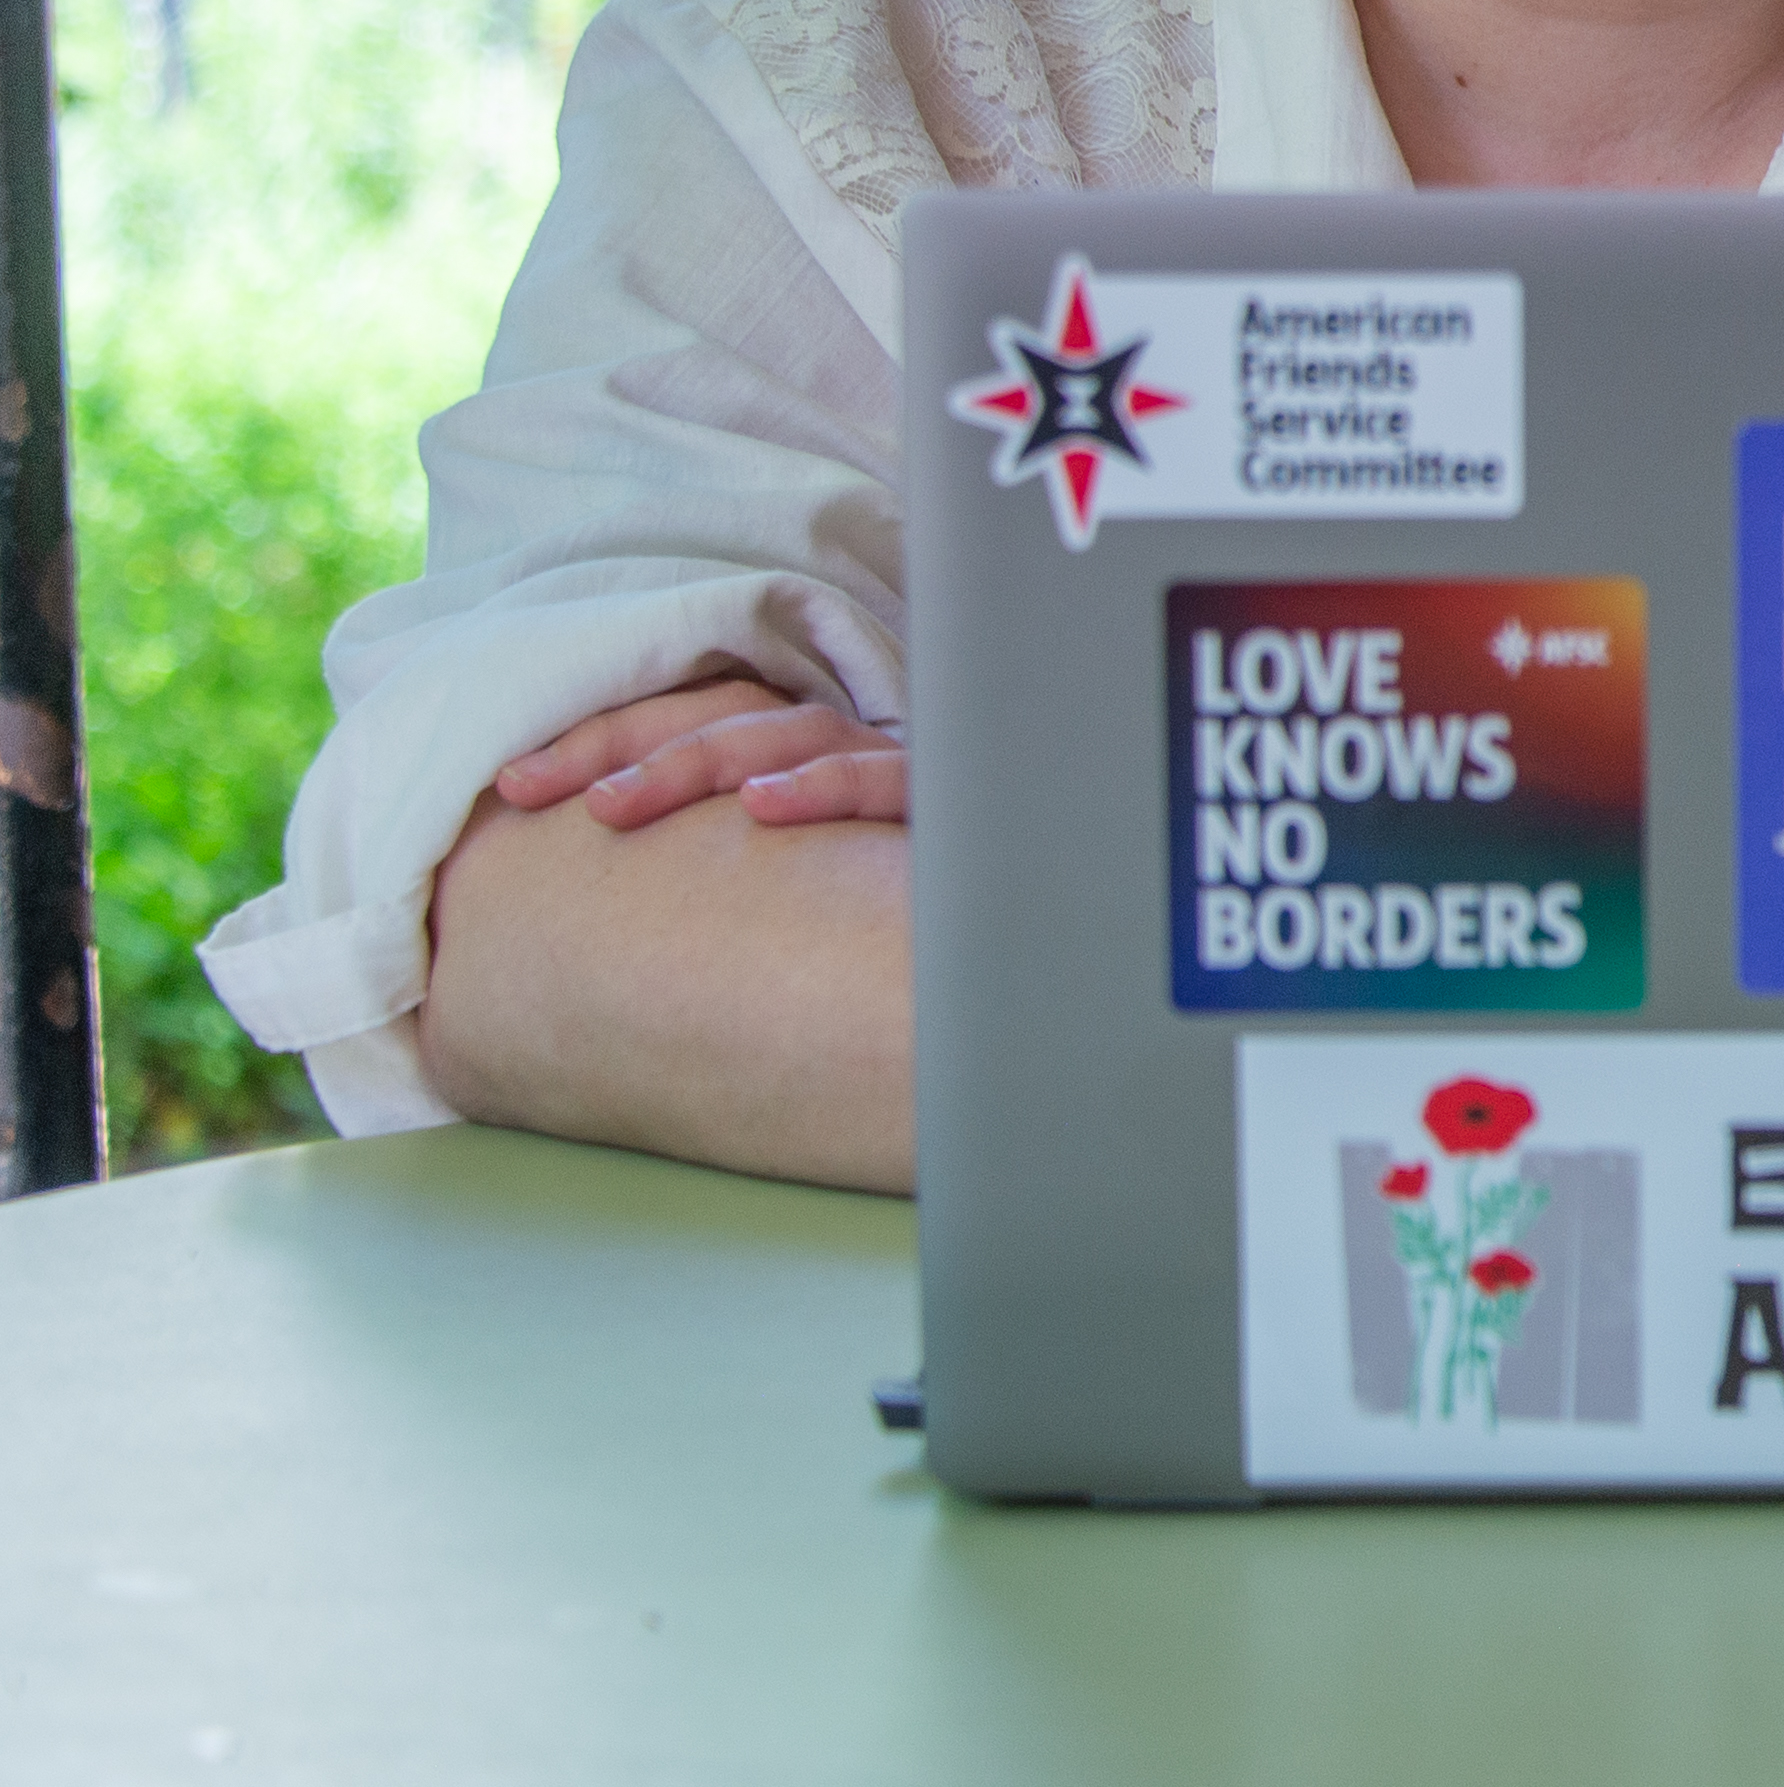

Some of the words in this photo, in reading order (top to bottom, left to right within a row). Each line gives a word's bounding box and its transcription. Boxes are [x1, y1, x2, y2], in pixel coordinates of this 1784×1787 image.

[1238, 296, 1471, 343] American
[1237, 348, 1414, 396] Friends
[1240, 400, 1408, 442] Service
[1239, 446, 1501, 493] Committee
[1196, 628, 1402, 715] LOVE
[1197, 714, 1515, 801] KNOWS
[1199, 802, 1327, 883] NO
[1201, 883, 1586, 969] BORDERS
